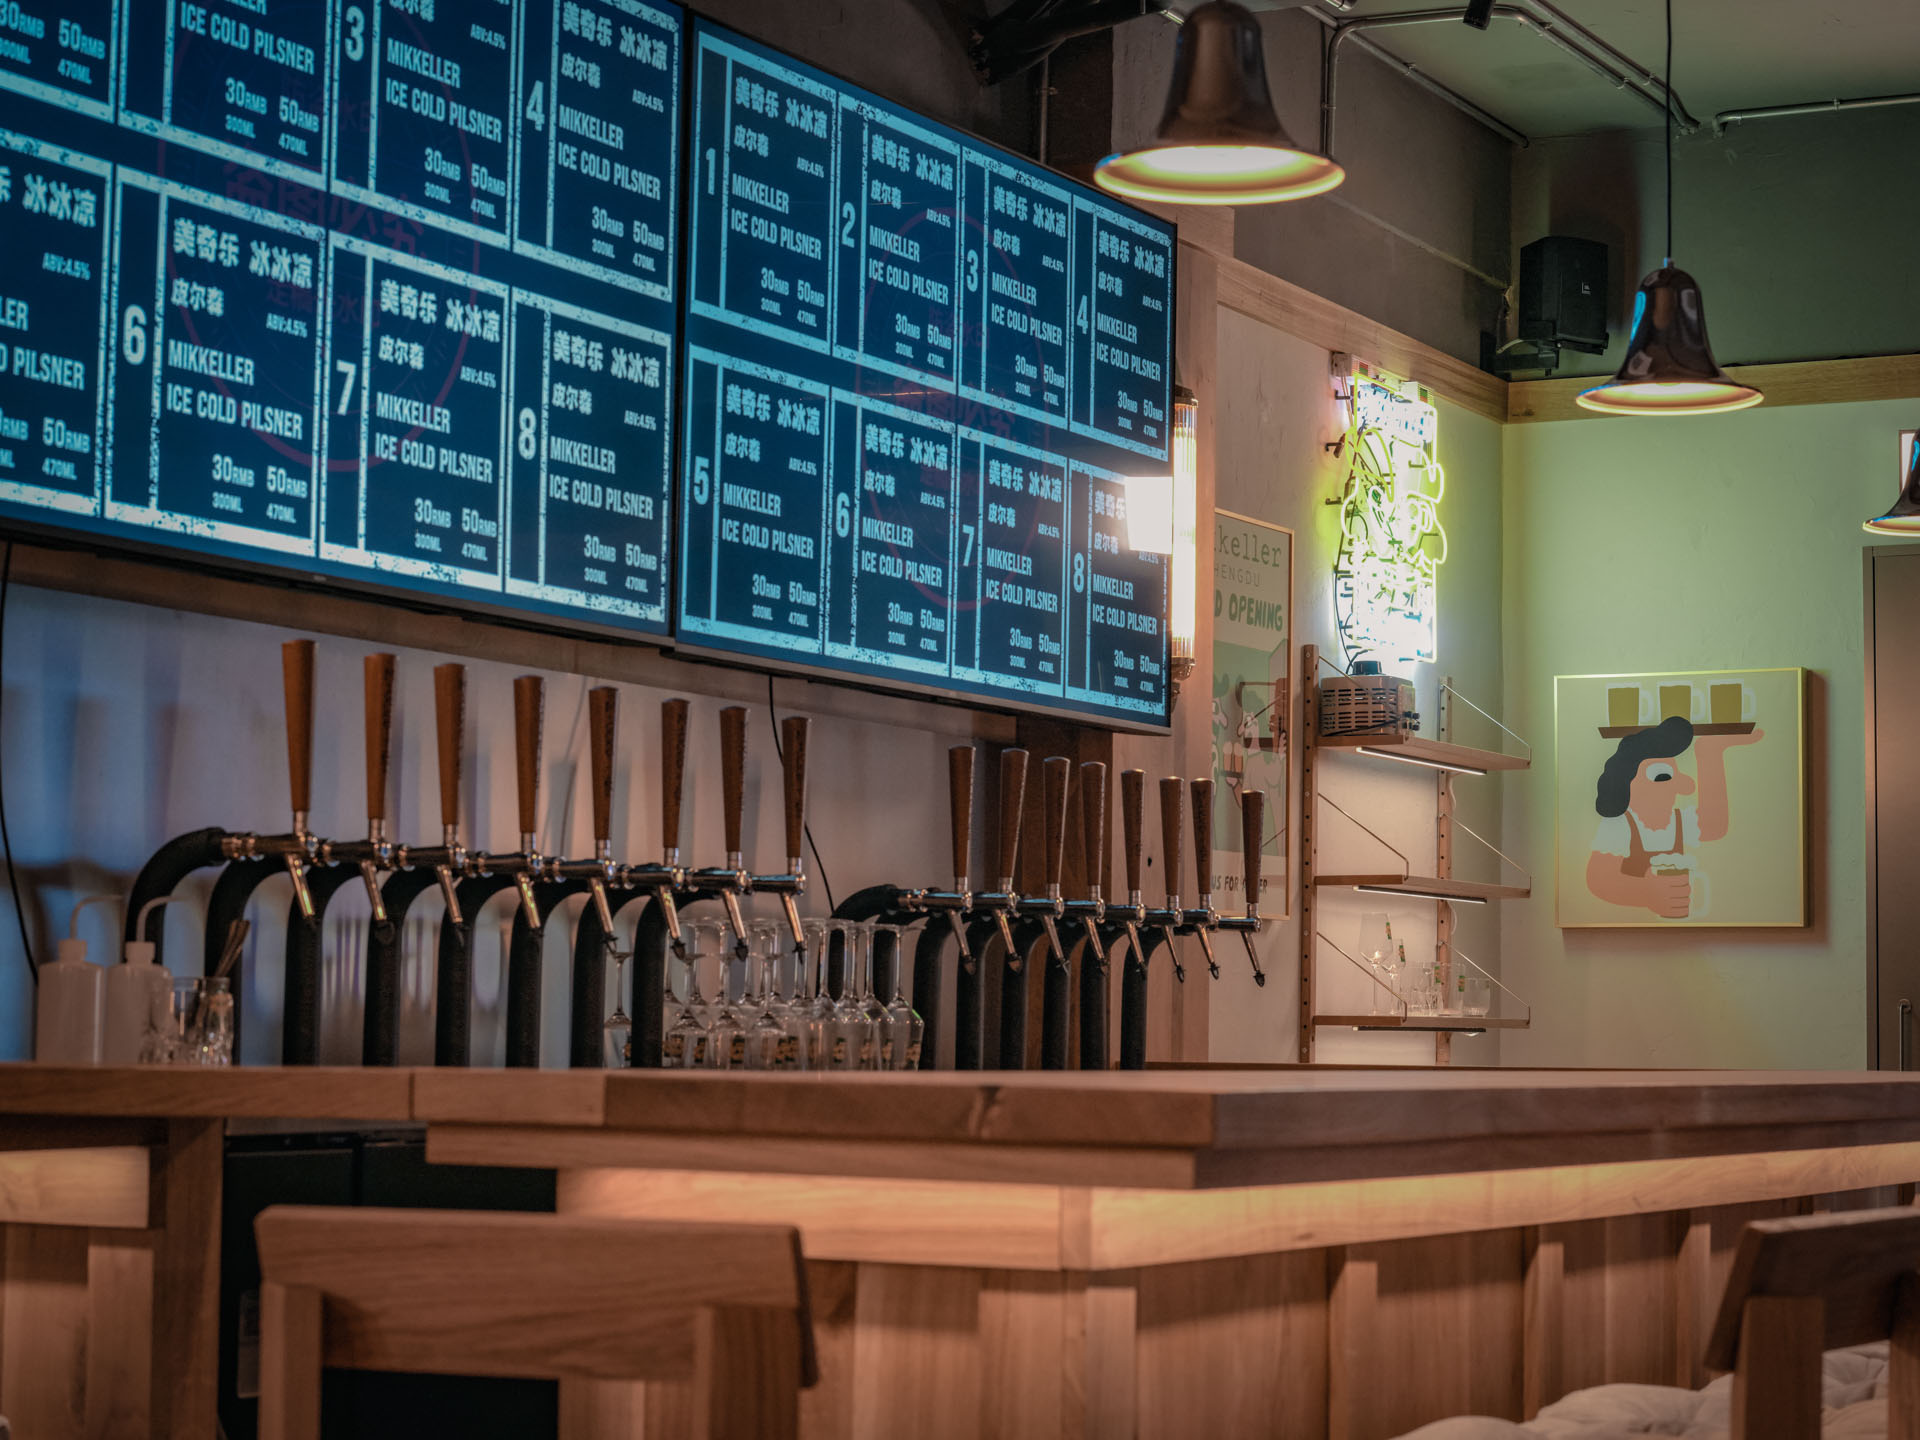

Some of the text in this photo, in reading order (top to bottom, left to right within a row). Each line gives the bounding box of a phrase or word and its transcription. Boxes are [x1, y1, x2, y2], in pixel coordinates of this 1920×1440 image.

[181, 2, 206, 35] ICE
[211, 13, 249, 50] COLD
[254, 29, 314, 74] PILSNER
[345, 6, 364, 61] 3
[387, 38, 460, 88] MIKKELLER
[386, 78, 502, 143] ICE COLD PILSNER
[526, 80, 544, 131] 4
[559, 104, 623, 150] MIKKELLER
[558, 142, 660, 200] ICE COLD PILSNER
[706, 148, 715, 195] 1
[732, 174, 789, 214] MIKKELLER
[731, 208, 821, 260] ICE COLD PILSNER
[842, 202, 855, 248] 2
[870, 225, 920, 262] MIKKELLER
[869, 258, 948, 305] ICE COLD PILSNER
[967, 250, 978, 292] 3
[992, 272, 1036, 306] MIKKELLER
[124, 306, 146, 364] 6
[992, 303, 1062, 346] ICE COLD PILSNER
[1077, 295, 1088, 334] 4
[1097, 312, 1137, 344] MIKKELLER
[13, 347, 84, 390] PILSNER
[168, 339, 254, 386] MIKKELLER
[1097, 342, 1160, 382] ICE COLD PILSNER
[337, 360, 356, 415] 7
[167, 383, 302, 440] ICE COLD PILSNER
[376, 392, 450, 434] MIKKELLER
[518, 408, 536, 460] 8
[550, 436, 615, 474] MIKKELLER
[376, 432, 492, 483] ICE COLD PILSNER
[550, 474, 653, 520] ICE COLD PILSNER
[694, 456, 709, 504] 5
[723, 482, 781, 516] MIKKELLER
[836, 492, 850, 537] 6
[862, 517, 913, 548] MIKKELLER
[722, 518, 814, 559] ICE COLD PILSNER
[963, 524, 974, 566] 7
[1214, 525, 1281, 567] keller
[862, 550, 942, 587] ICE COLD PILSNER
[987, 547, 1032, 576] MIKKELLER
[1074, 553, 1084, 592] 8
[986, 579, 1058, 613] ICE COLD PILSNER
[1093, 574, 1133, 600] MIKKELLER
[1093, 604, 1157, 635] ICE COLD PILSNER
[1229, 593, 1283, 631] OPENING
[1224, 875, 1239, 892] FOR
